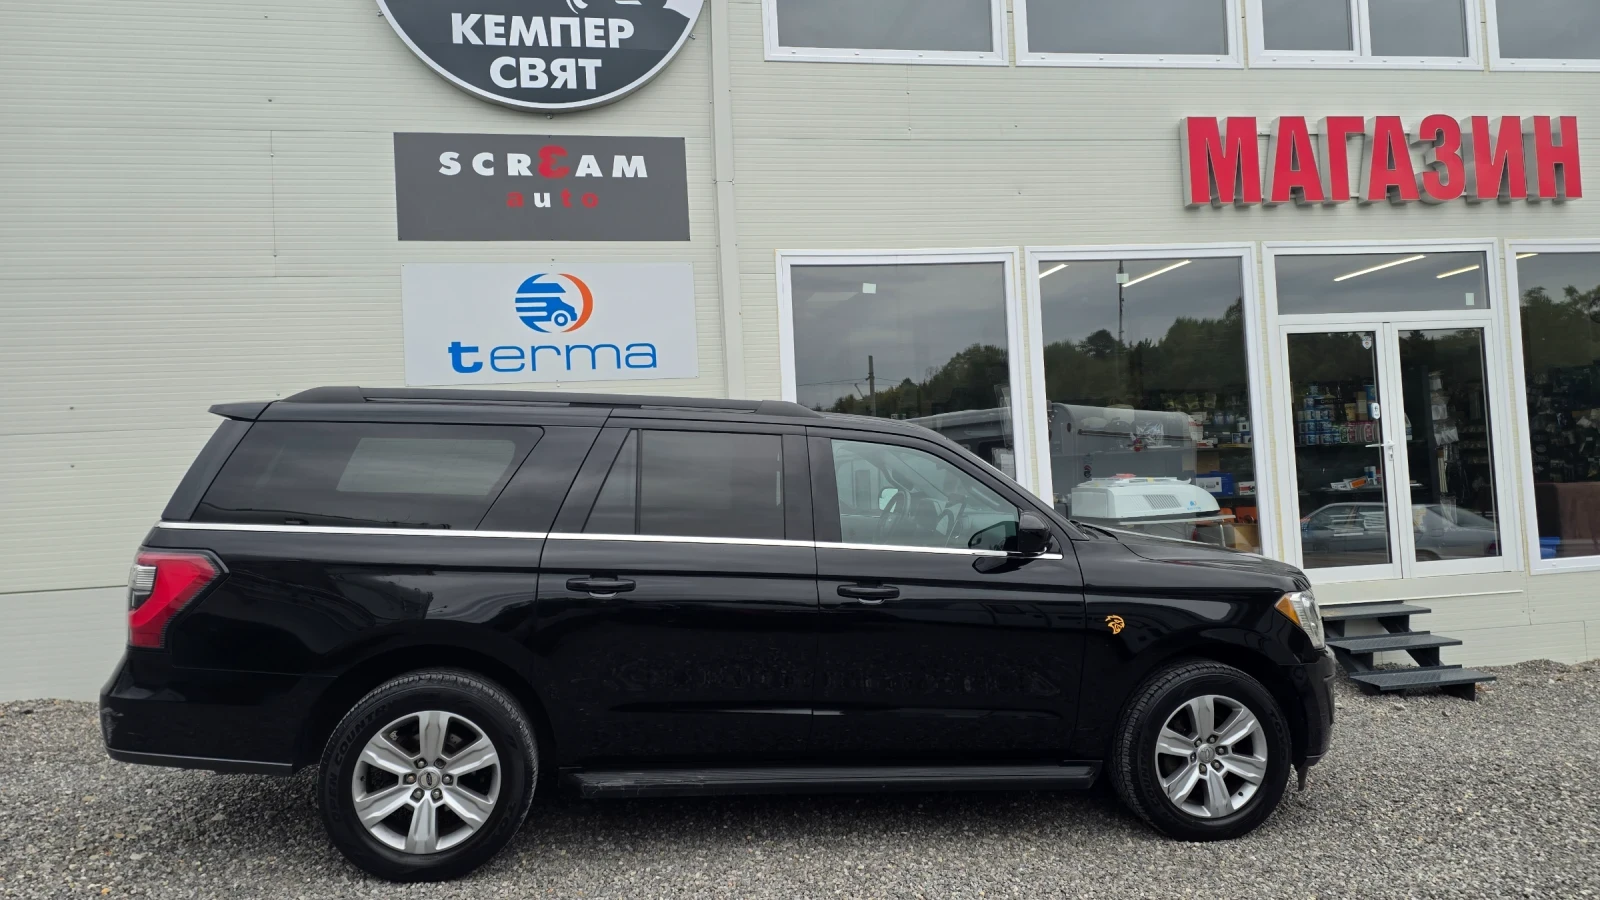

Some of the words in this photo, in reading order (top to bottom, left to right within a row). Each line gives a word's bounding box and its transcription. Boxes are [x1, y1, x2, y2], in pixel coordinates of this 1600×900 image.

[451, 13, 635, 49] КЕМПЕР
[489, 56, 603, 90] СВЯТ
[1186, 113, 1583, 204] МАГАЗИН
[506, 188, 600, 209] auto
[447, 341, 658, 374] terma
[334, 700, 393, 766] COUNTR
